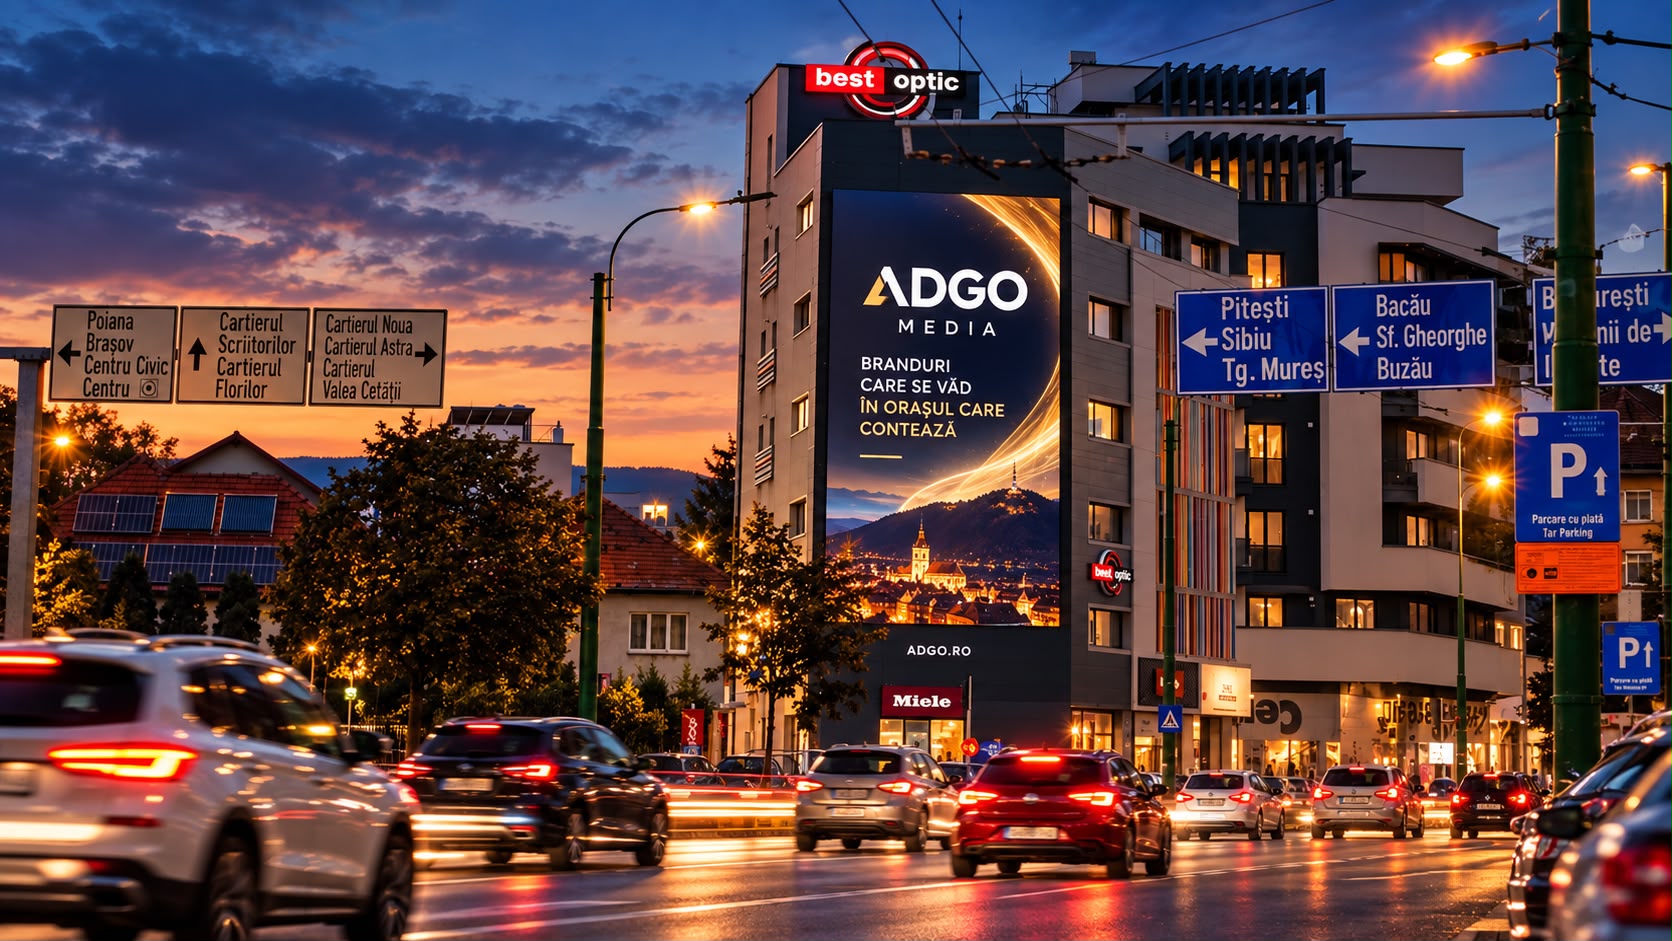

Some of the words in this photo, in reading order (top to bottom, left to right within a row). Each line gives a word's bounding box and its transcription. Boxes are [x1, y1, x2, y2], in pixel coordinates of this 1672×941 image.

[816, 67, 874, 87] best
[894, 72, 959, 93] optic
[863, 266, 1028, 311] ADGO
[1221, 295, 1289, 323] Pitești
[1376, 294, 1430, 317] Bacău
[88, 310, 134, 330] Poiana
[220, 312, 283, 332] Cartierul
[326, 313, 378, 333] Cartierul
[382, 314, 413, 334] Noua
[898, 319, 996, 336] MEDIA
[1222, 326, 1271, 350] Sibiu
[1376, 324, 1399, 348] Sf.
[1404, 322, 1487, 351] Gheorghe
[1627, 318, 1651, 343] de
[86, 333, 134, 356] Brașov
[218, 334, 296, 354] Scriitorilor
[325, 336, 377, 355] Cartierul
[380, 337, 413, 356] Astra
[84, 354, 131, 374] Centru
[136, 355, 168, 375] Civic
[217, 356, 281, 376] Cartierul
[323, 357, 375, 377] Cartierul
[861, 356, 950, 373] BRANDURI
[1222, 357, 1255, 388] Tg.
[1261, 357, 1325, 383] Mureș
[1377, 357, 1432, 380] Buzău
[83, 377, 130, 397] Centru
[216, 379, 268, 398] Florilor
[323, 380, 356, 399] Valea
[361, 380, 402, 403] Cetății
[861, 378, 906, 393] CARE
[911, 379, 932, 393] SE
[936, 378, 972, 394] VĂD
[860, 396, 878, 414] ÎN
[883, 400, 954, 419] ORAȘUL
[959, 402, 1005, 417] CARE
[860, 421, 957, 437] CONTEAZĂ
[1550, 443, 1587, 498] P
[1532, 514, 1566, 524] Parcare
[1568, 515, 1579, 524] cu
[907, 645, 971, 656] ADGO.RO
[893, 695, 951, 708] Miele
